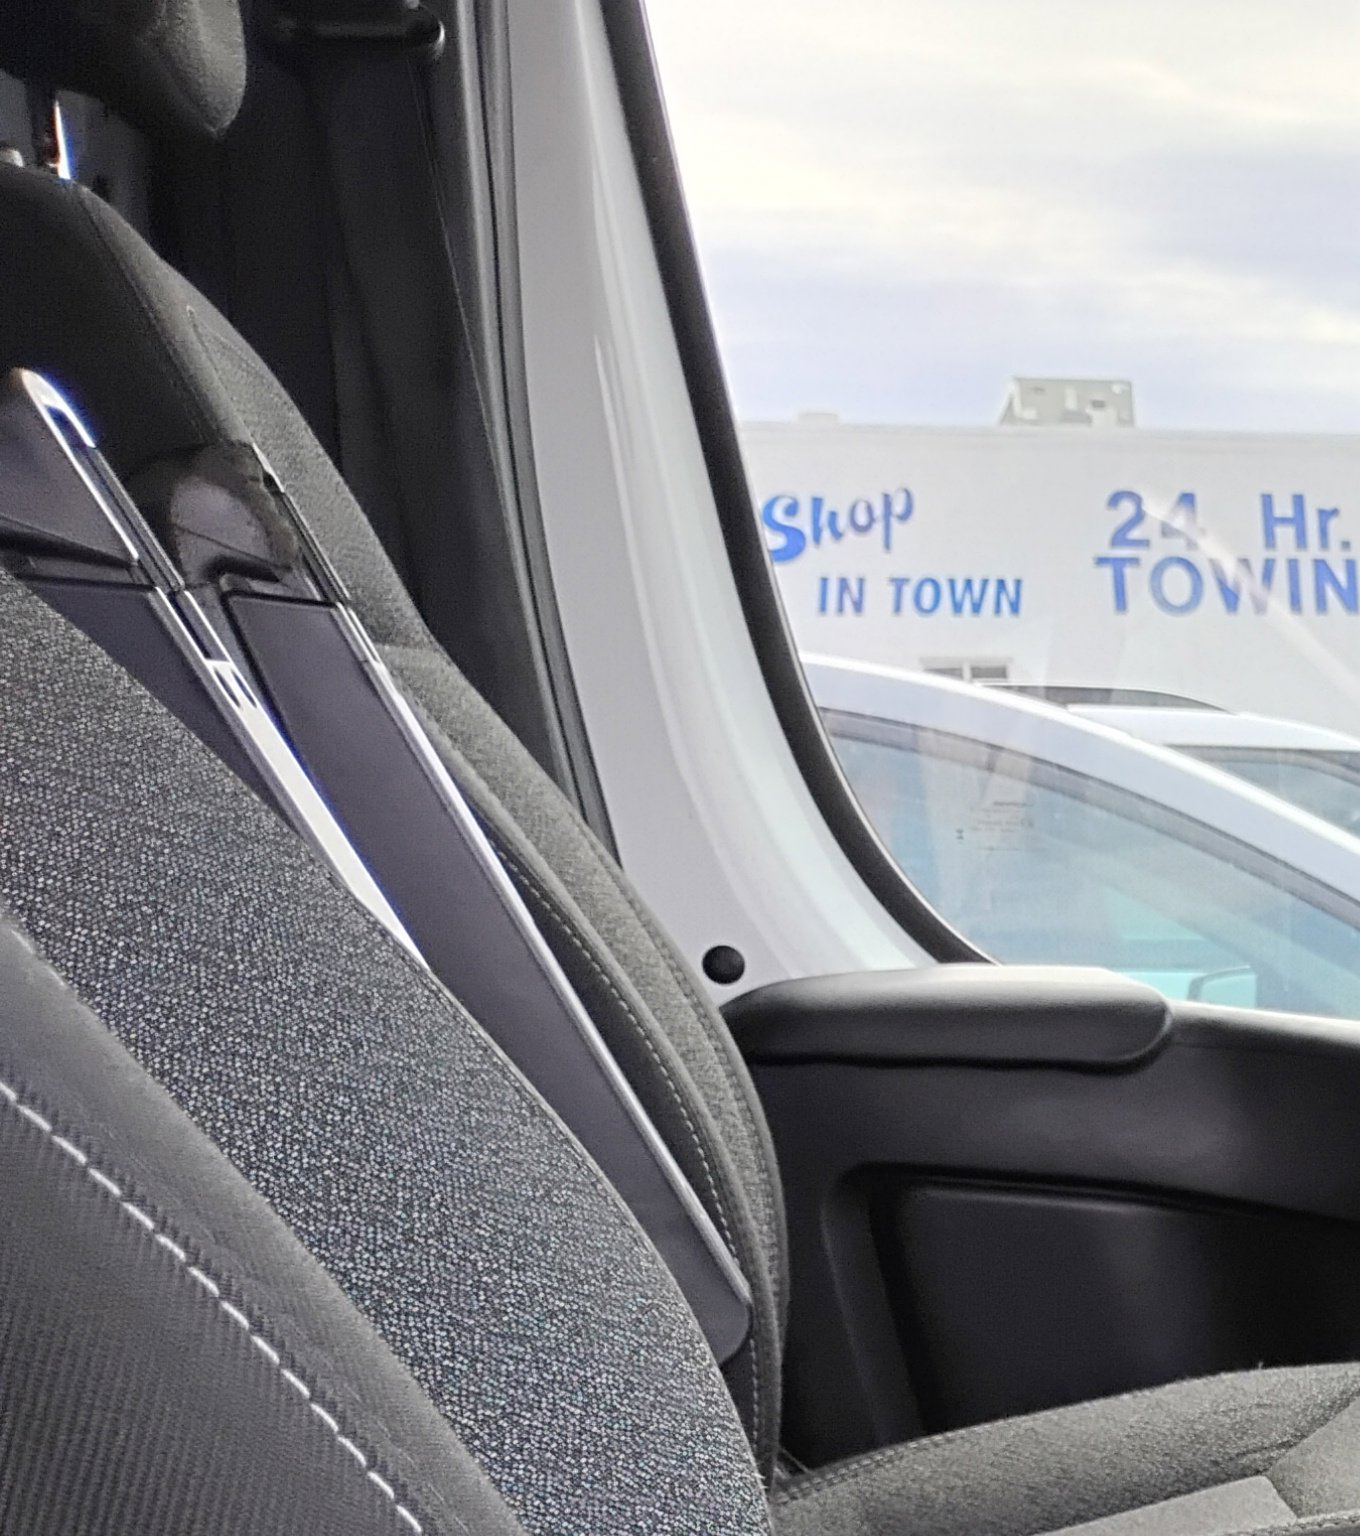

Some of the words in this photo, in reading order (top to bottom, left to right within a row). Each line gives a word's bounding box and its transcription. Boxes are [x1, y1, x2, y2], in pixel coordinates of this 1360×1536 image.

[762, 487, 914, 563] Shop
[1106, 490, 1200, 550] 24
[1260, 493, 1352, 551] Hr.
[818, 576, 865, 616] IN
[889, 576, 1022, 616] TOWN
